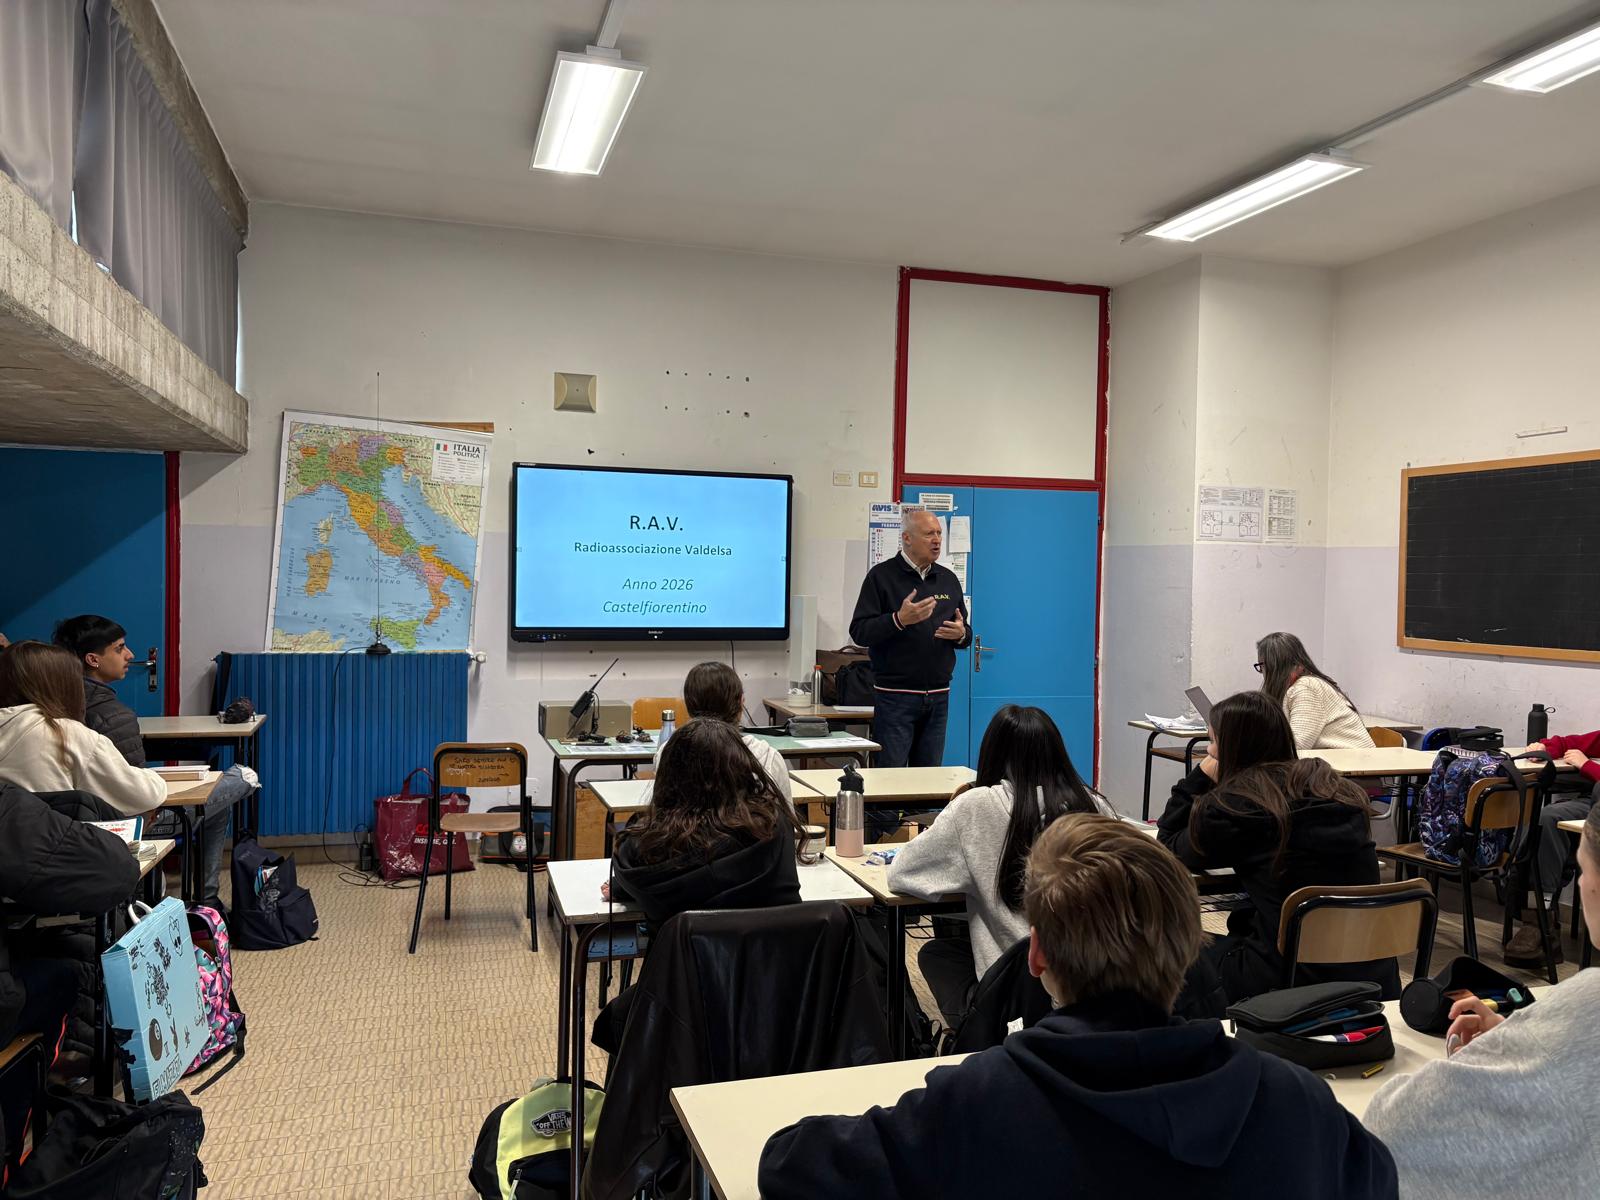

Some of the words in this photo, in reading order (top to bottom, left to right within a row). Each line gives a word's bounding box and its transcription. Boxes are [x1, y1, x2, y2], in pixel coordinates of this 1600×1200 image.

[453, 443, 481, 454] ITALIA
[453, 451, 480, 459] POLITICA
[871, 504, 892, 512] AVIS
[630, 515, 684, 531] R.A.V.
[574, 541, 682, 555] Radioassociazione
[685, 544, 732, 556] Valdelsa
[622, 577, 657, 591] Anno
[660, 578, 694, 591] 2026
[603, 600, 707, 616] Castelfiorentino
